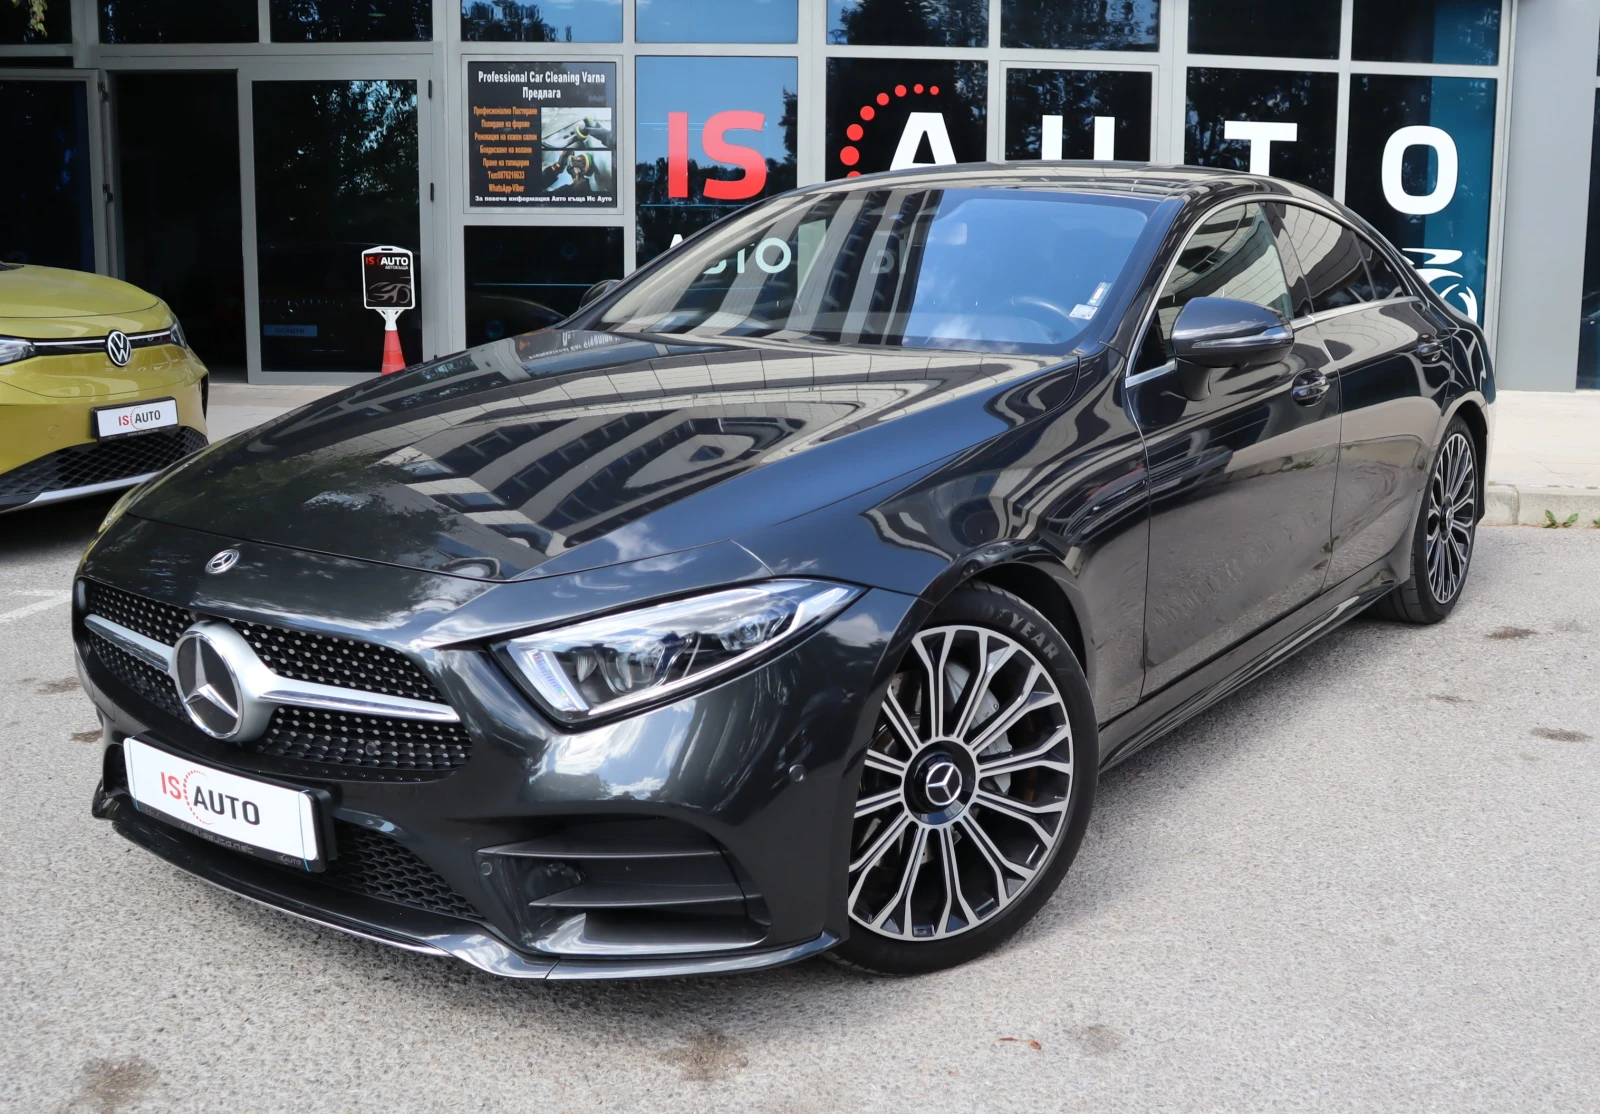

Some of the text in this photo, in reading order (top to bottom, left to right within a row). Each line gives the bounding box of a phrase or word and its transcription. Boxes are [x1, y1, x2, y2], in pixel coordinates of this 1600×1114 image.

[478, 71, 605, 85] Professional Car Cleaning Varna
[522, 87, 561, 100] Предлага
[668, 110, 767, 199] IS
[365, 257, 409, 266] IS AUTO
[118, 409, 161, 427] IS AUTO
[160, 772, 260, 826] IS AUTO
